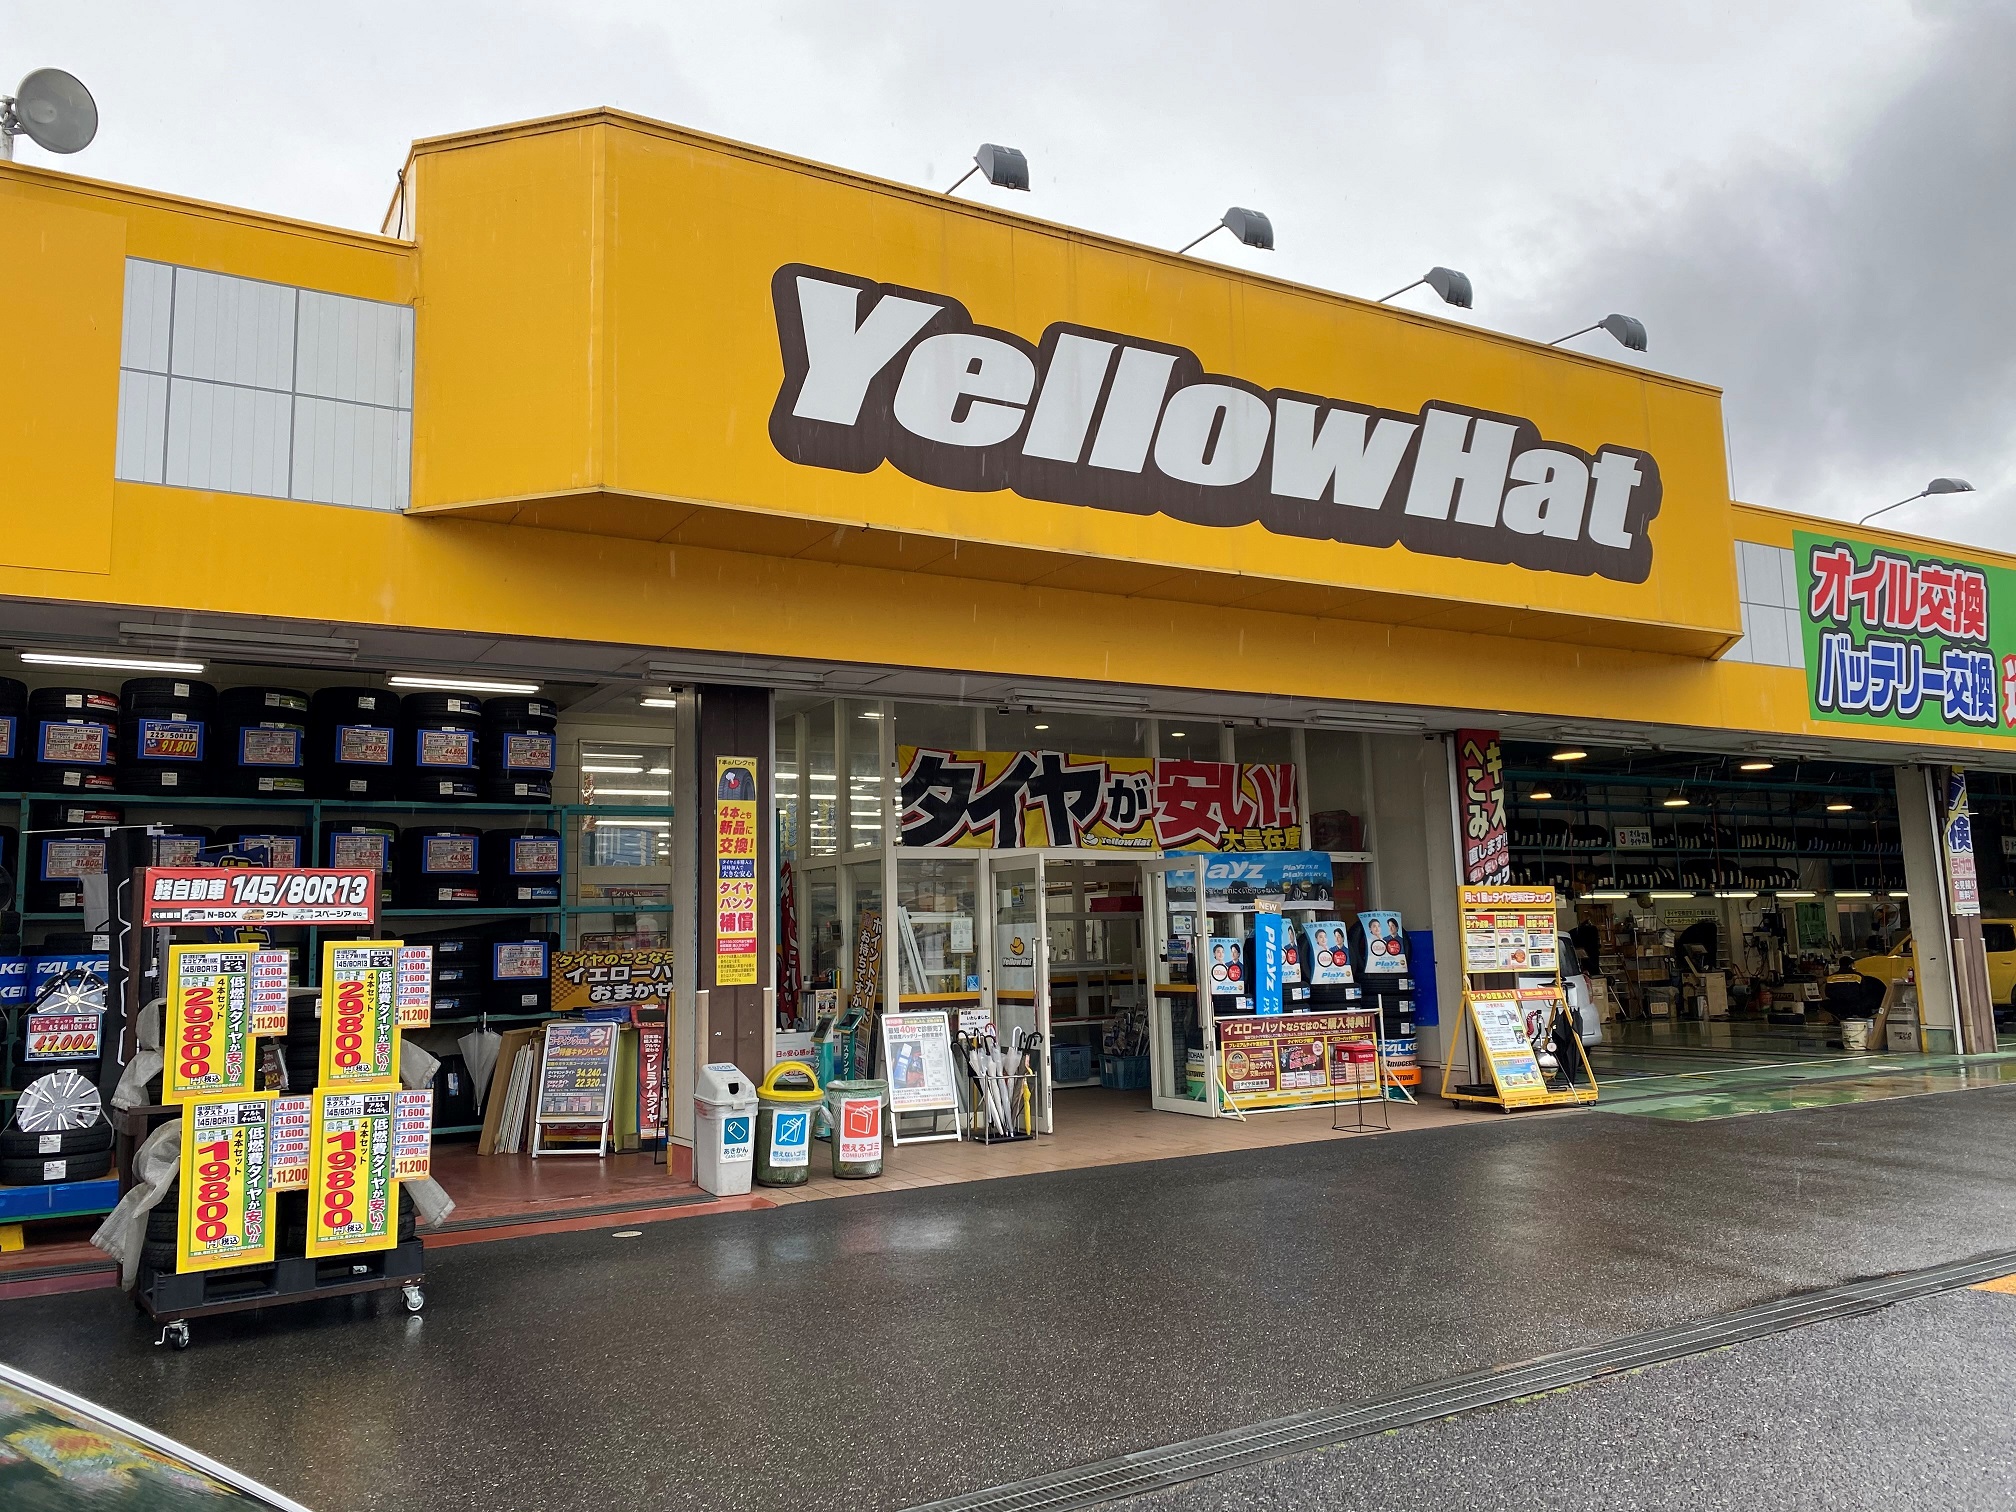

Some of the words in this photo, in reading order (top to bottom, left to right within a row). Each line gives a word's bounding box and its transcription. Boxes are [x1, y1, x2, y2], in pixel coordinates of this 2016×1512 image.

[1811, 548, 1987, 641] オイル交換
[1819, 632, 1998, 722] バッテリー交換
[1463, 740, 1490, 840] へこみ
[720, 806, 752, 819] 4本とも
[719, 820, 753, 836] 新品に
[1221, 827, 1301, 851] 大量在庫
[1619, 831, 1627, 845] 3
[719, 837, 754, 854] 交換!
[153, 878, 227, 901] 軽自動車
[232, 875, 367, 905] 145/80R13
[720, 881, 754, 895] タイヤ
[1464, 891, 1552, 904] 月に1回はタイヤ空気圧チェック
[720, 896, 754, 909] パンク
[1259, 902, 1277, 911] NEW
[207, 911, 238, 919] N-BOX
[266, 910, 288, 918] タント
[315, 910, 351, 918] スペーシア
[720, 912, 755, 933] 補償
[559, 951, 673, 967] タイヤのことなら
[852, 929, 871, 1008] お持ちですか
[1265, 925, 1277, 992] Playz
[1321, 970, 1345, 978] Playz
[217, 978, 226, 1020] 4本セット
[366, 973, 375, 1013] 4本セット
[590, 982, 673, 1001] おまかせ
[226, 975, 246, 1083] 低燃費タイヤが安い!!
[334, 981, 365, 1068] 29,800
[355, 1063, 371, 1072] 税込
[375, 970, 393, 1073] 低燃費タイヤが安い!!
[1225, 1015, 1371, 1036] イエローハットならではのご購入特典!!
[34, 1033, 96, 1052] 47,000
[180, 987, 214, 1078] 29,800
[203, 1074, 220, 1083] 税込
[590, 1027, 612, 1046] 今!
[575, 1078, 600, 1088] 22,320
[646, 1053, 659, 1123] プレミアムタイヤ
[234, 1130, 243, 1176] 4本セット
[360, 1120, 369, 1166] 4本セット
[723, 1146, 749, 1155] あきかん
[841, 1142, 880, 1153] 燃えるゴミ
[841, 1151, 880, 1159] COMBUSTIBLES
[245, 1126, 266, 1243] 低燃費タイヤが安い!!
[323, 1131, 357, 1228] 19,800
[346, 1223, 363, 1233] 税込
[369, 1117, 389, 1231] 低燃費タイヤが安い!!
[195, 1140, 231, 1242] 19,800
[220, 1235, 239, 1246] 税込
